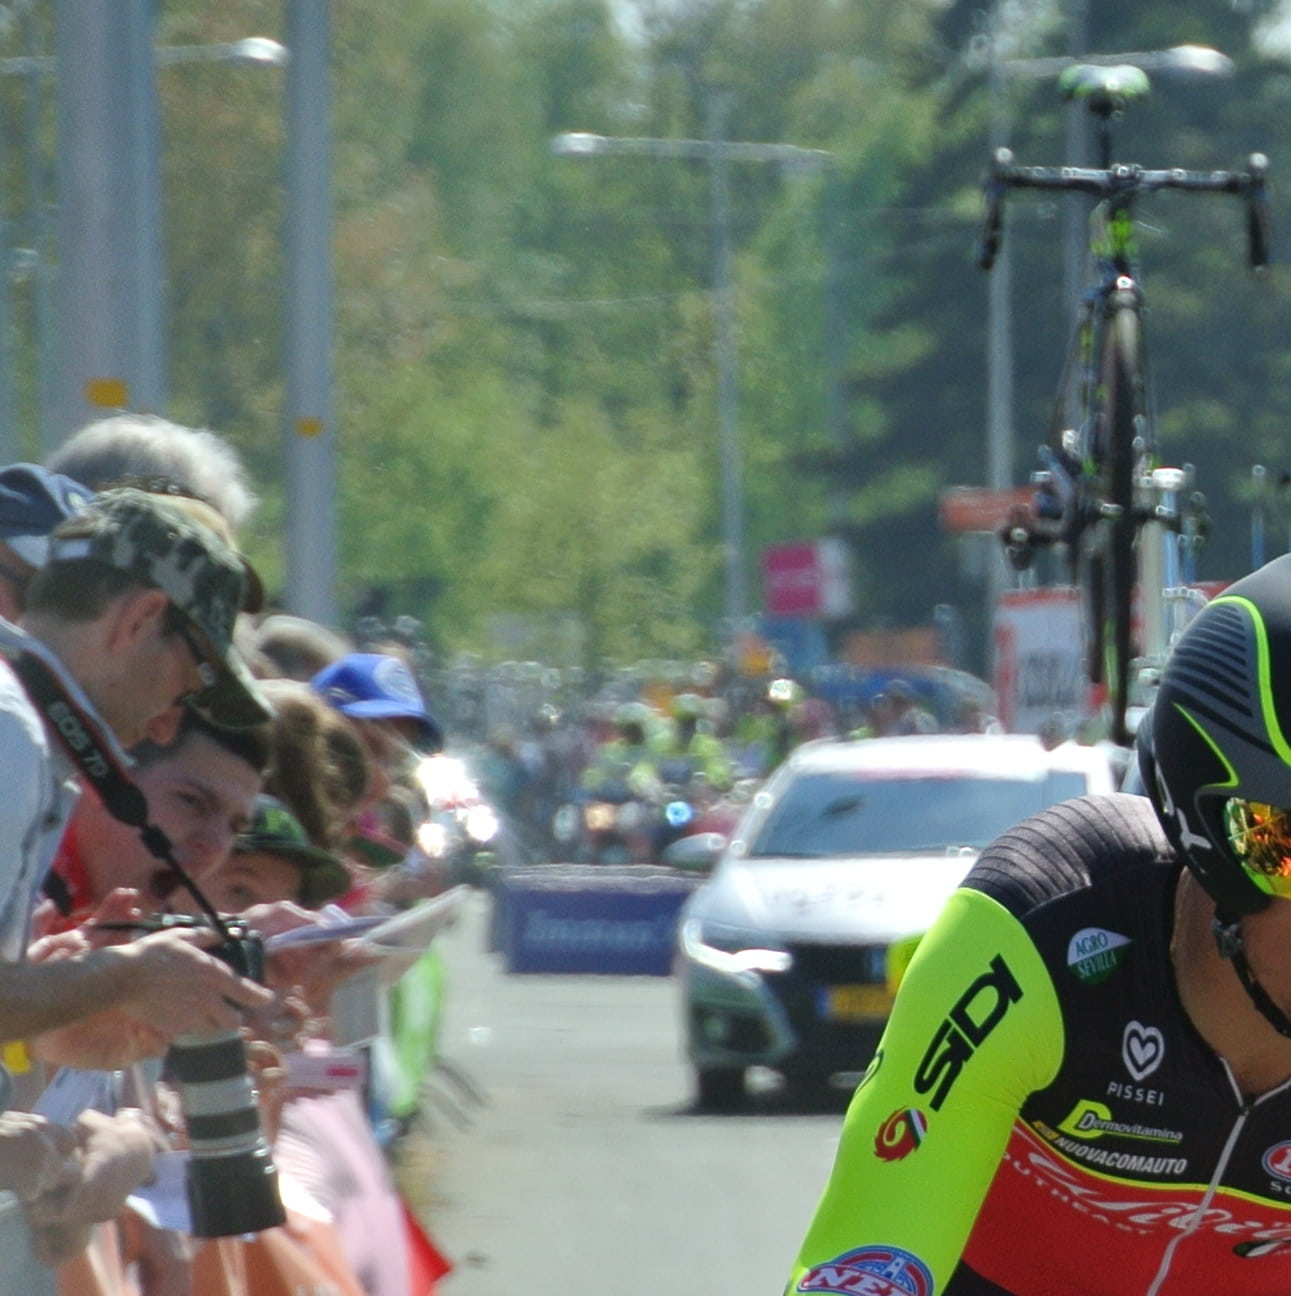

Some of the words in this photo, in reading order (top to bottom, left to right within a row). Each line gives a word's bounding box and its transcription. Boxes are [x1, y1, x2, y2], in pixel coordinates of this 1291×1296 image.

[48, 701, 91, 750] EOS
[1075, 932, 1109, 957] AGRO
[1077, 951, 1117, 979] SEVILLA
[914, 953, 1024, 1112] SIDI
[1106, 1081, 1165, 1107] PISSEI
[1078, 1112, 1184, 1142] Dermovitamina
[1054, 1137, 1188, 1175] NUOVACOMAUTO
